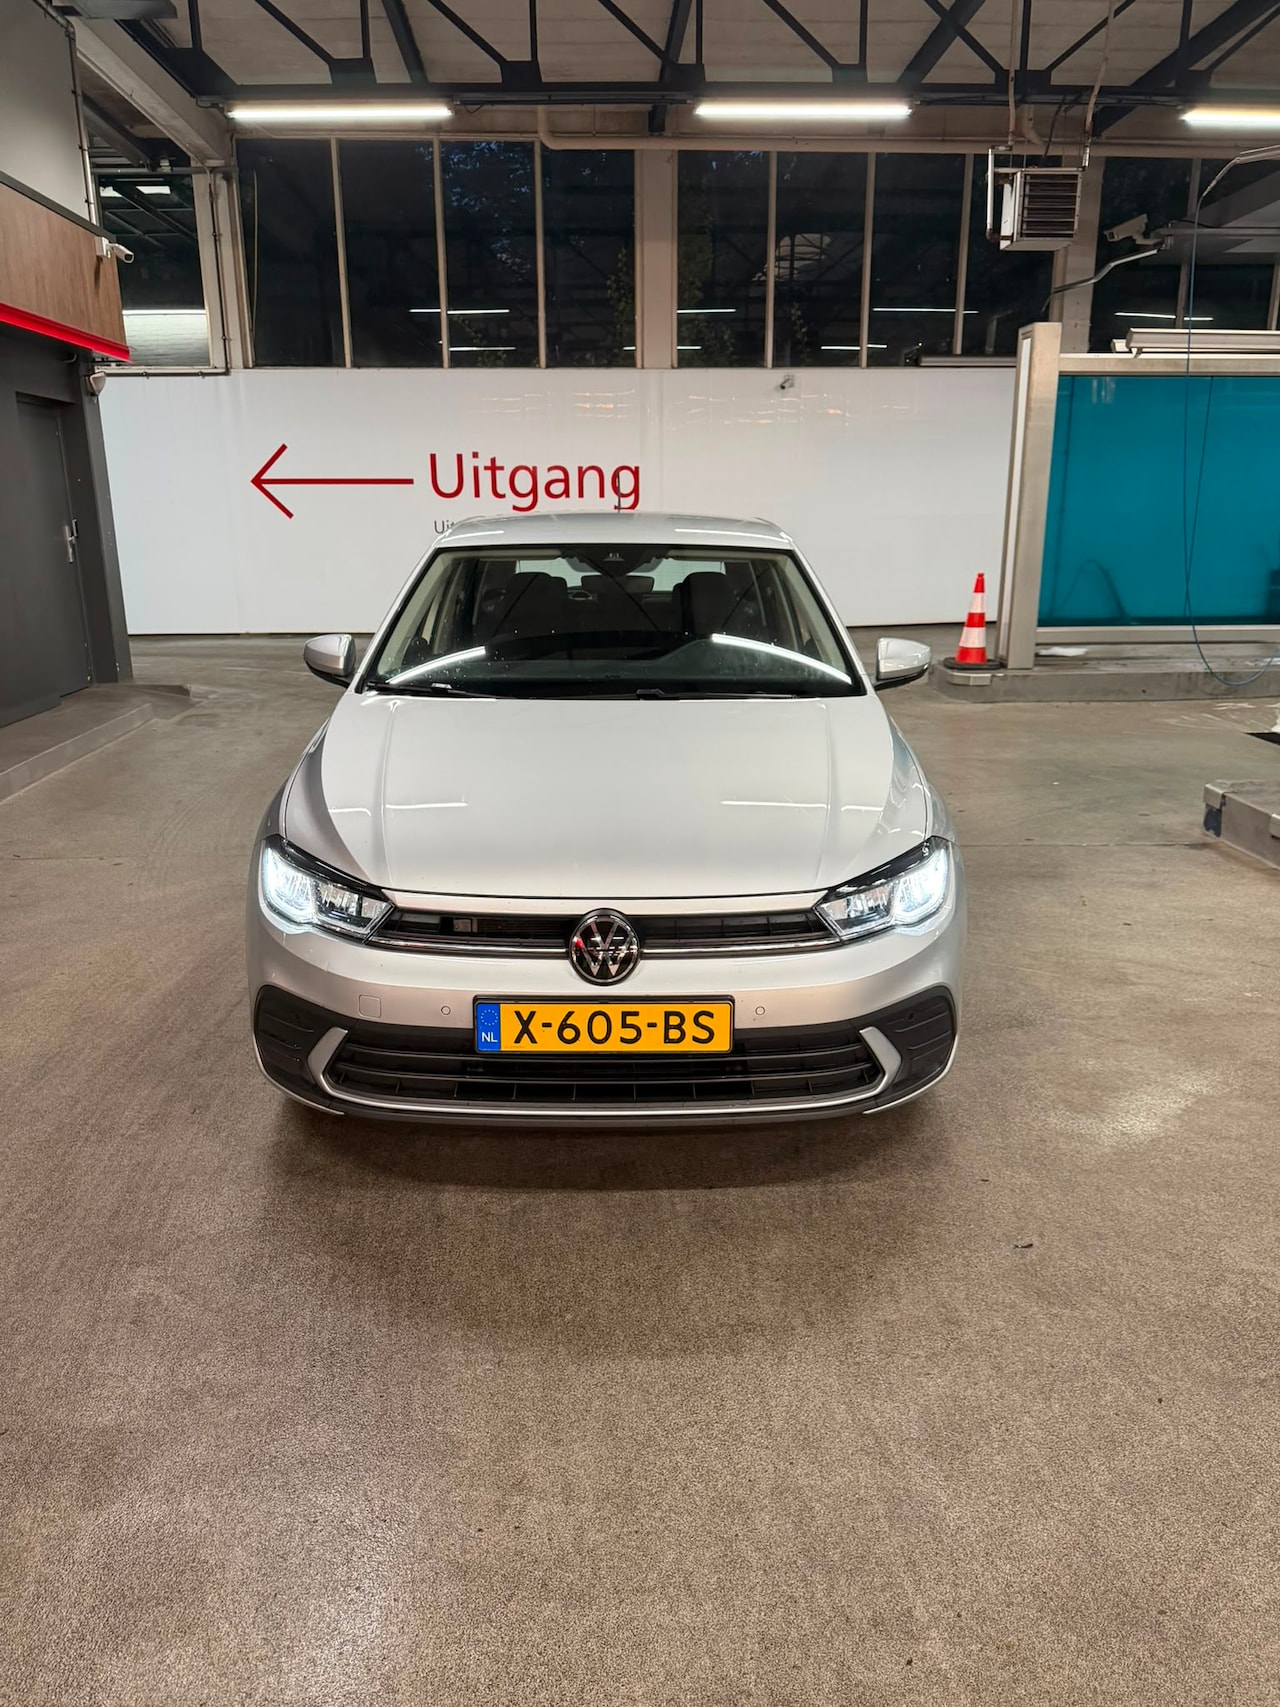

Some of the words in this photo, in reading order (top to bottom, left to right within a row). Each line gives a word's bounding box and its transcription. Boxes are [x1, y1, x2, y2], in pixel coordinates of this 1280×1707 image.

[429, 451, 640, 512] Uitgang
[434, 519, 456, 534] Ui
[481, 1031, 498, 1043] NL
[514, 1010, 715, 1044] X-605-BS
